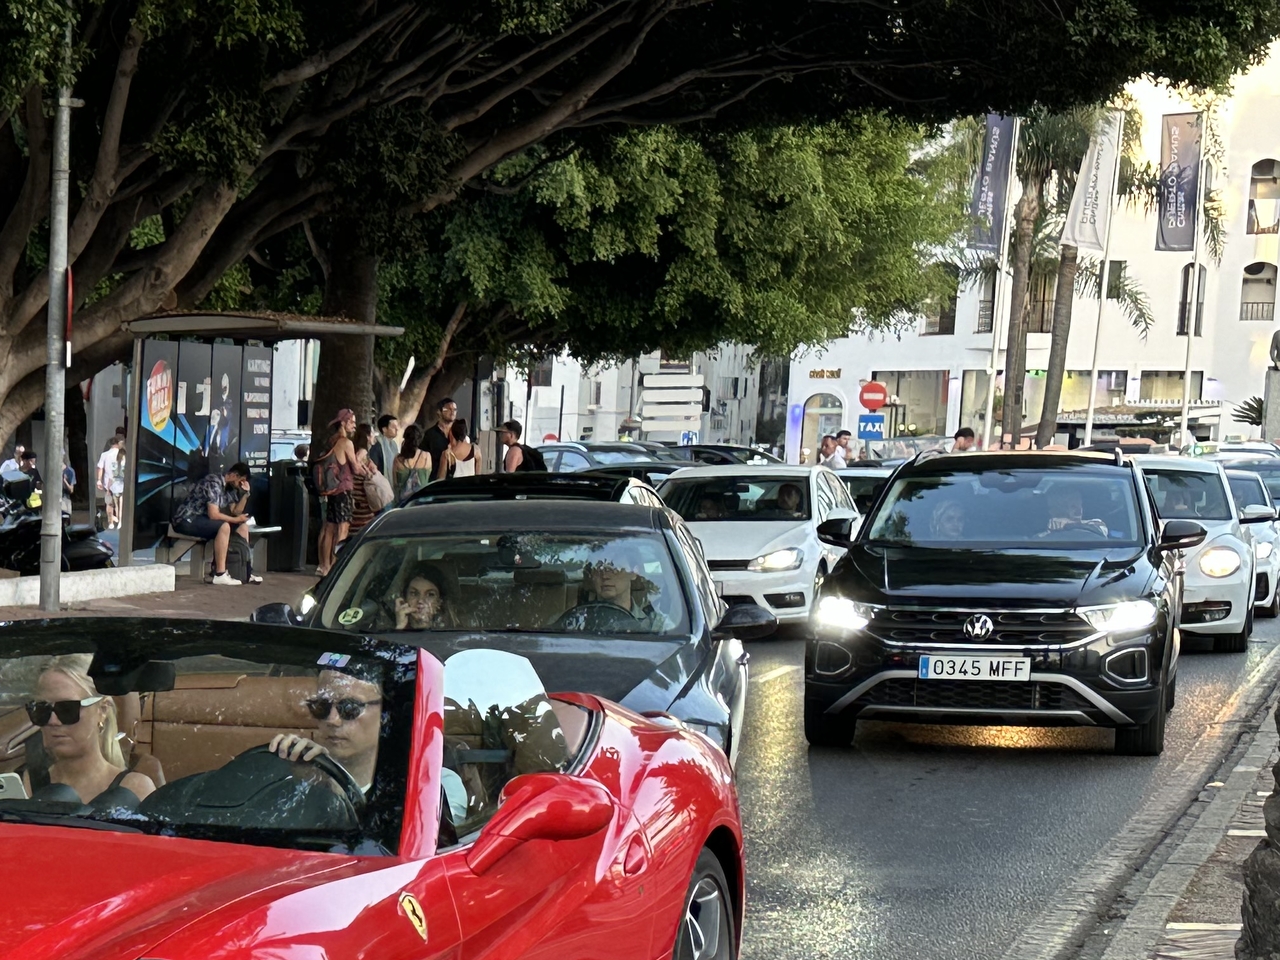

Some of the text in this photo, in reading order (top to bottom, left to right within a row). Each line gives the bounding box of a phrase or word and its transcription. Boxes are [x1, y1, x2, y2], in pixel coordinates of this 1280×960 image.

[859, 422, 884, 433] TAXI
[933, 660, 981, 676] 0345
[989, 660, 1026, 677] MFF
